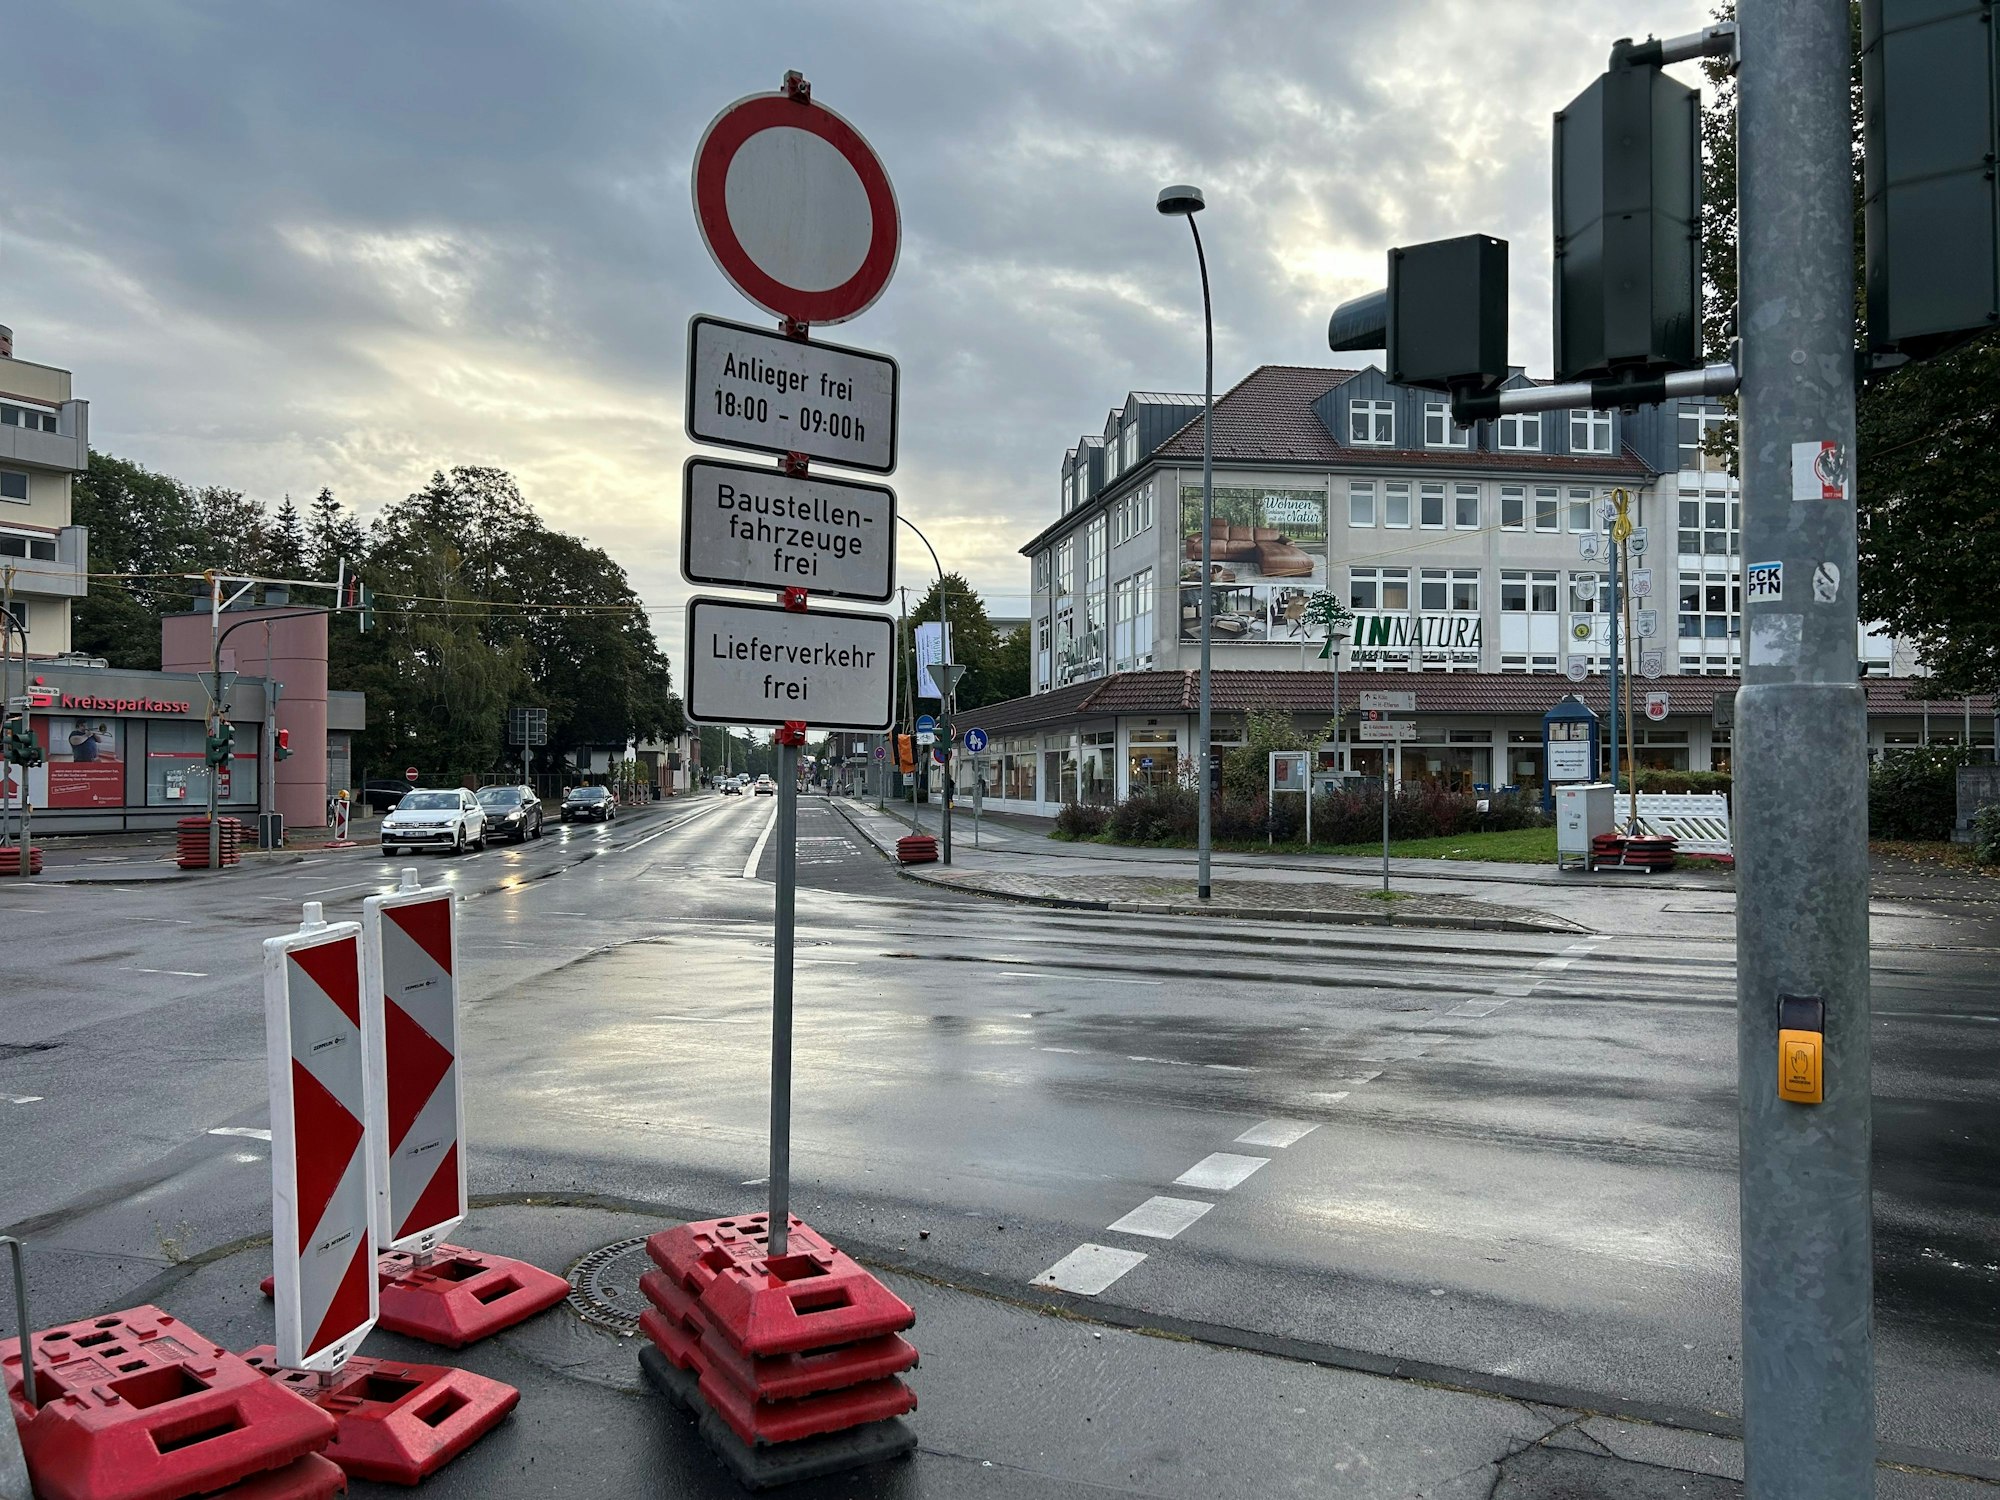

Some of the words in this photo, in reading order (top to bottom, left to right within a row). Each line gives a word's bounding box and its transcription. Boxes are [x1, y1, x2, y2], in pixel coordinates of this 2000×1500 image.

[723, 352, 809, 394] Anlieger
[821, 373, 853, 401] frei
[715, 389, 768, 423] 18:00
[718, 484, 873, 528] Baustellen-
[1264, 496, 1312, 509] Wohnen
[1287, 509, 1320, 522] Natur
[730, 514, 862, 559] fahrzeuge
[774, 548, 817, 576] frei
[1749, 568, 1781, 583] FCK
[1749, 581, 1781, 596] PTN
[1353, 616, 1482, 647] INNATURA
[713, 633, 875, 668] Lieferverkehr
[763, 674, 807, 700] frei
[61, 693, 190, 714] Kreissparkasse
